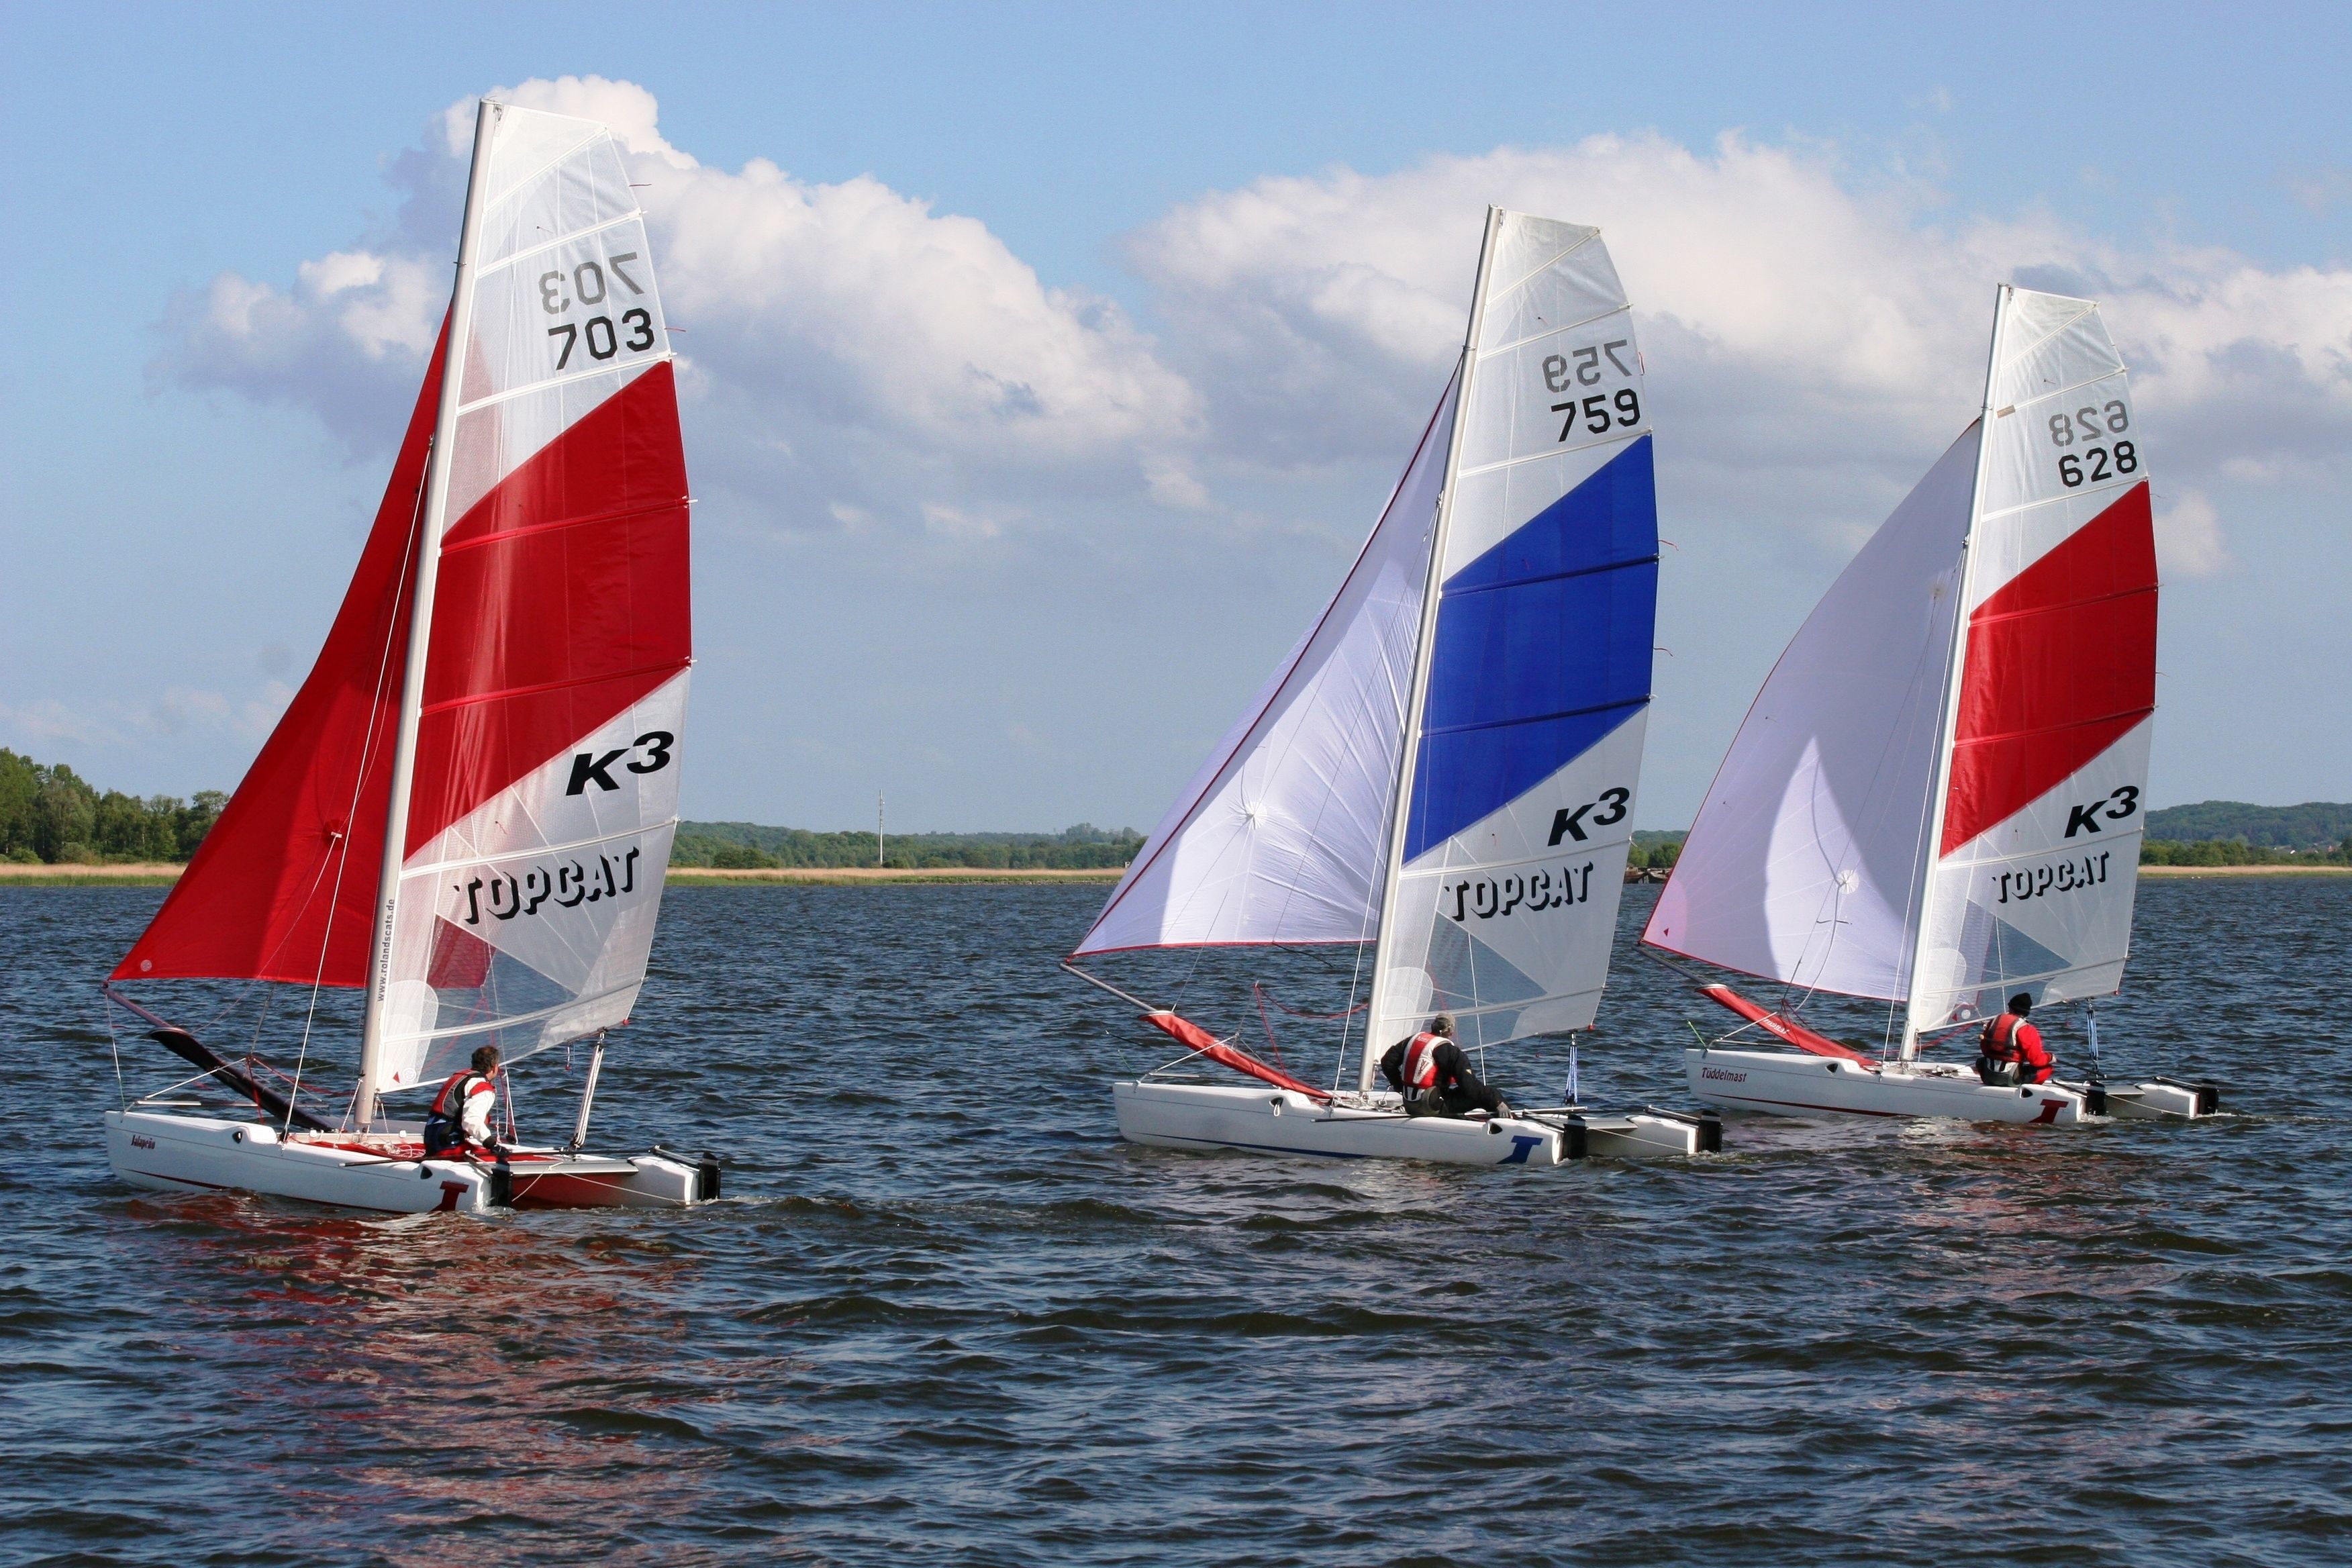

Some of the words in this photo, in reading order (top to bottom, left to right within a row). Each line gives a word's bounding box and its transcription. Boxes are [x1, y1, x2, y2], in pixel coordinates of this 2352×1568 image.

[547, 307, 655, 371] 703
[1551, 388, 1640, 442] 759
[2058, 440, 2138, 488] 628
[565, 730, 675, 796] K3
[1547, 787, 1630, 847] K3
[2063, 785, 2140, 838] K3
[451, 846, 640, 925] TOPCAT
[1443, 861, 1594, 922] TOPCAT
[1991, 850, 2110, 904] TOPCAT
[377, 899, 395, 1002] www.rolandscats.de
[1702, 1067, 1747, 1083] Tüddelmast
